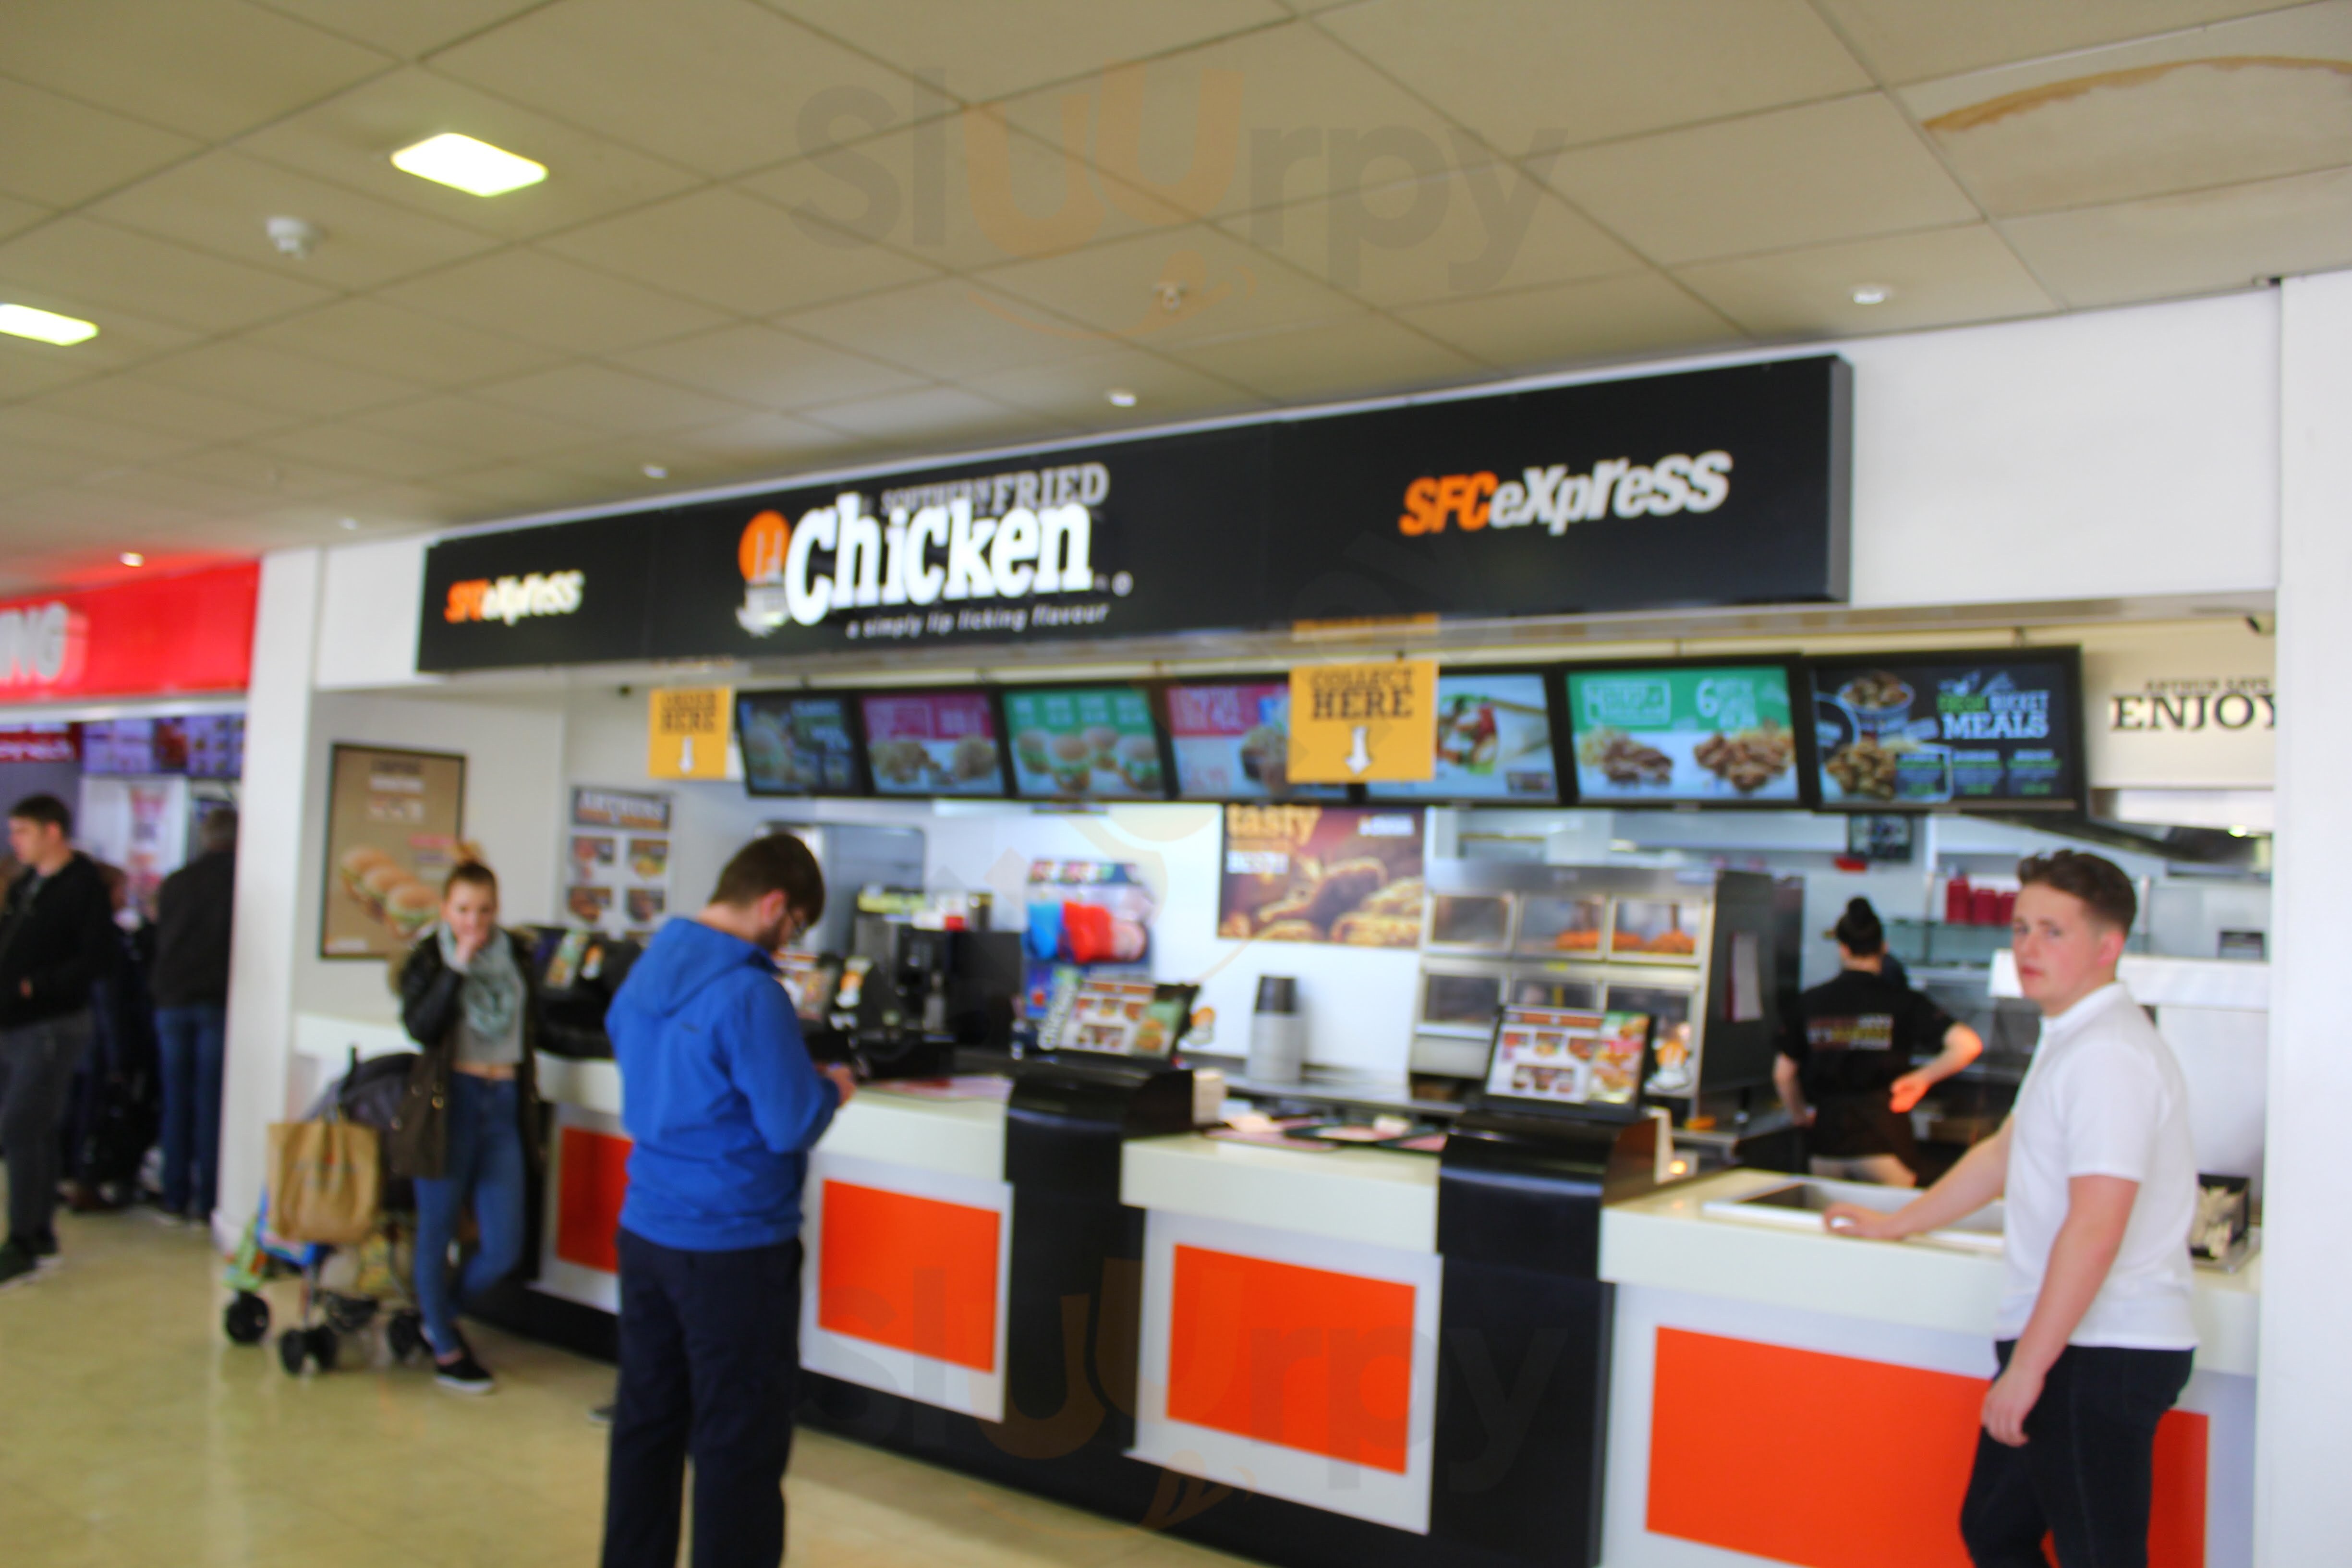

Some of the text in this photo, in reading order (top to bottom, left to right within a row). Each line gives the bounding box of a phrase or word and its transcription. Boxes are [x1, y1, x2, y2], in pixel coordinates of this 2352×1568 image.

[991, 462, 1110, 516] FRIED
[785, 491, 1093, 626] Chicken
[846, 603, 1110, 640] a simply lip licking flavour
[1312, 689, 1413, 719] HERE
[1942, 711, 2049, 740] MEALS
[1227, 803, 1322, 847] tasty
